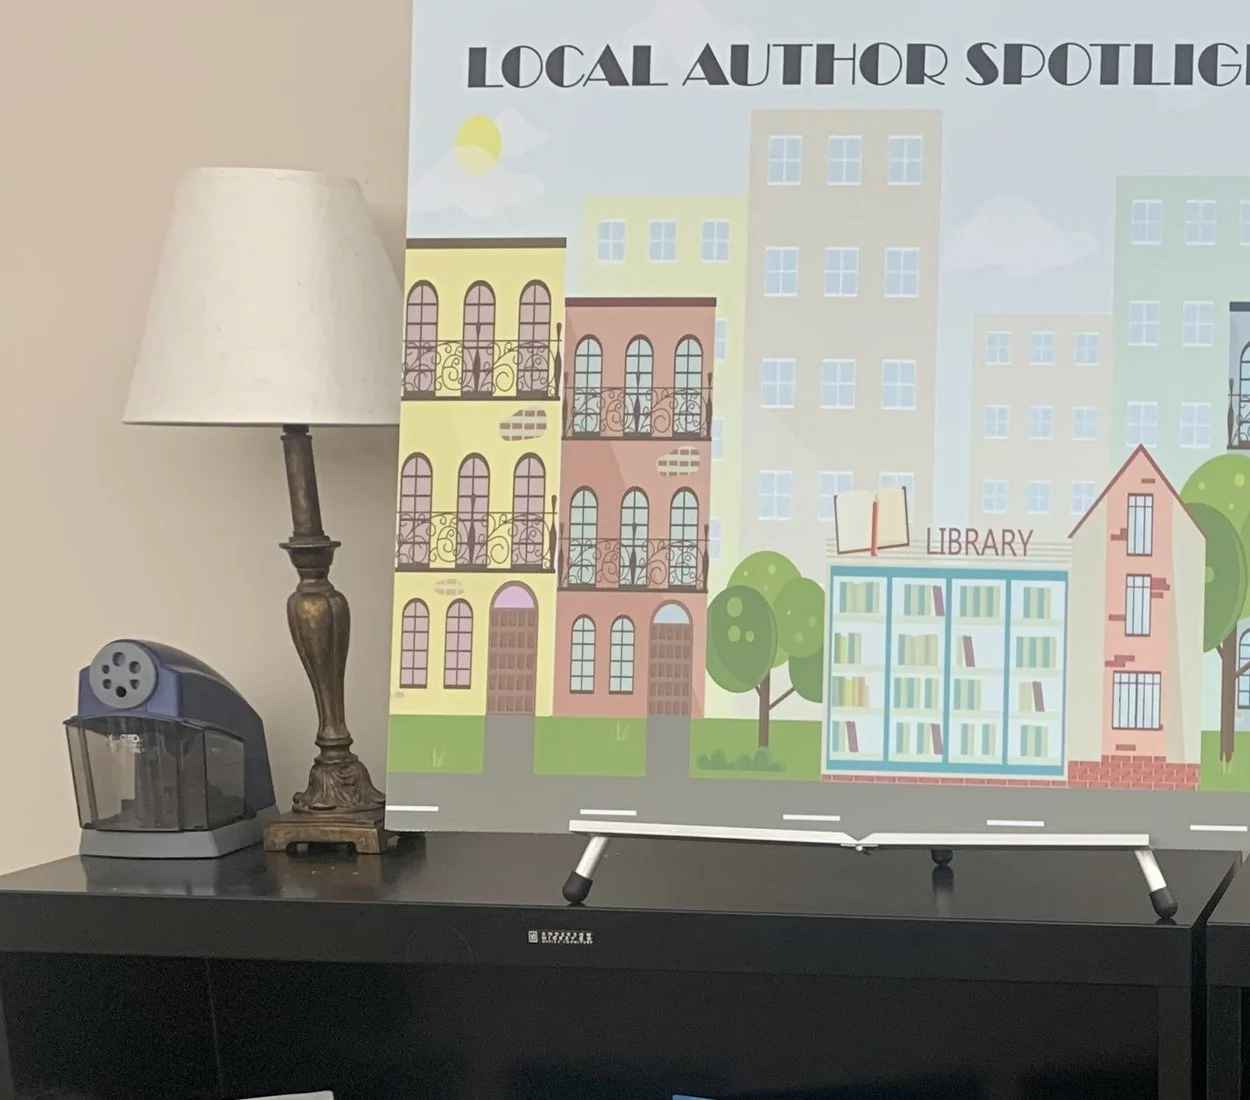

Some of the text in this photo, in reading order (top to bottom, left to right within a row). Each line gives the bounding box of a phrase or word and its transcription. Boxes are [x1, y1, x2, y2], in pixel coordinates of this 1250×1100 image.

[467, 43, 667, 89] LOCAL
[682, 42, 949, 87] AUTHOR
[925, 527, 1034, 557] LIBRARY
